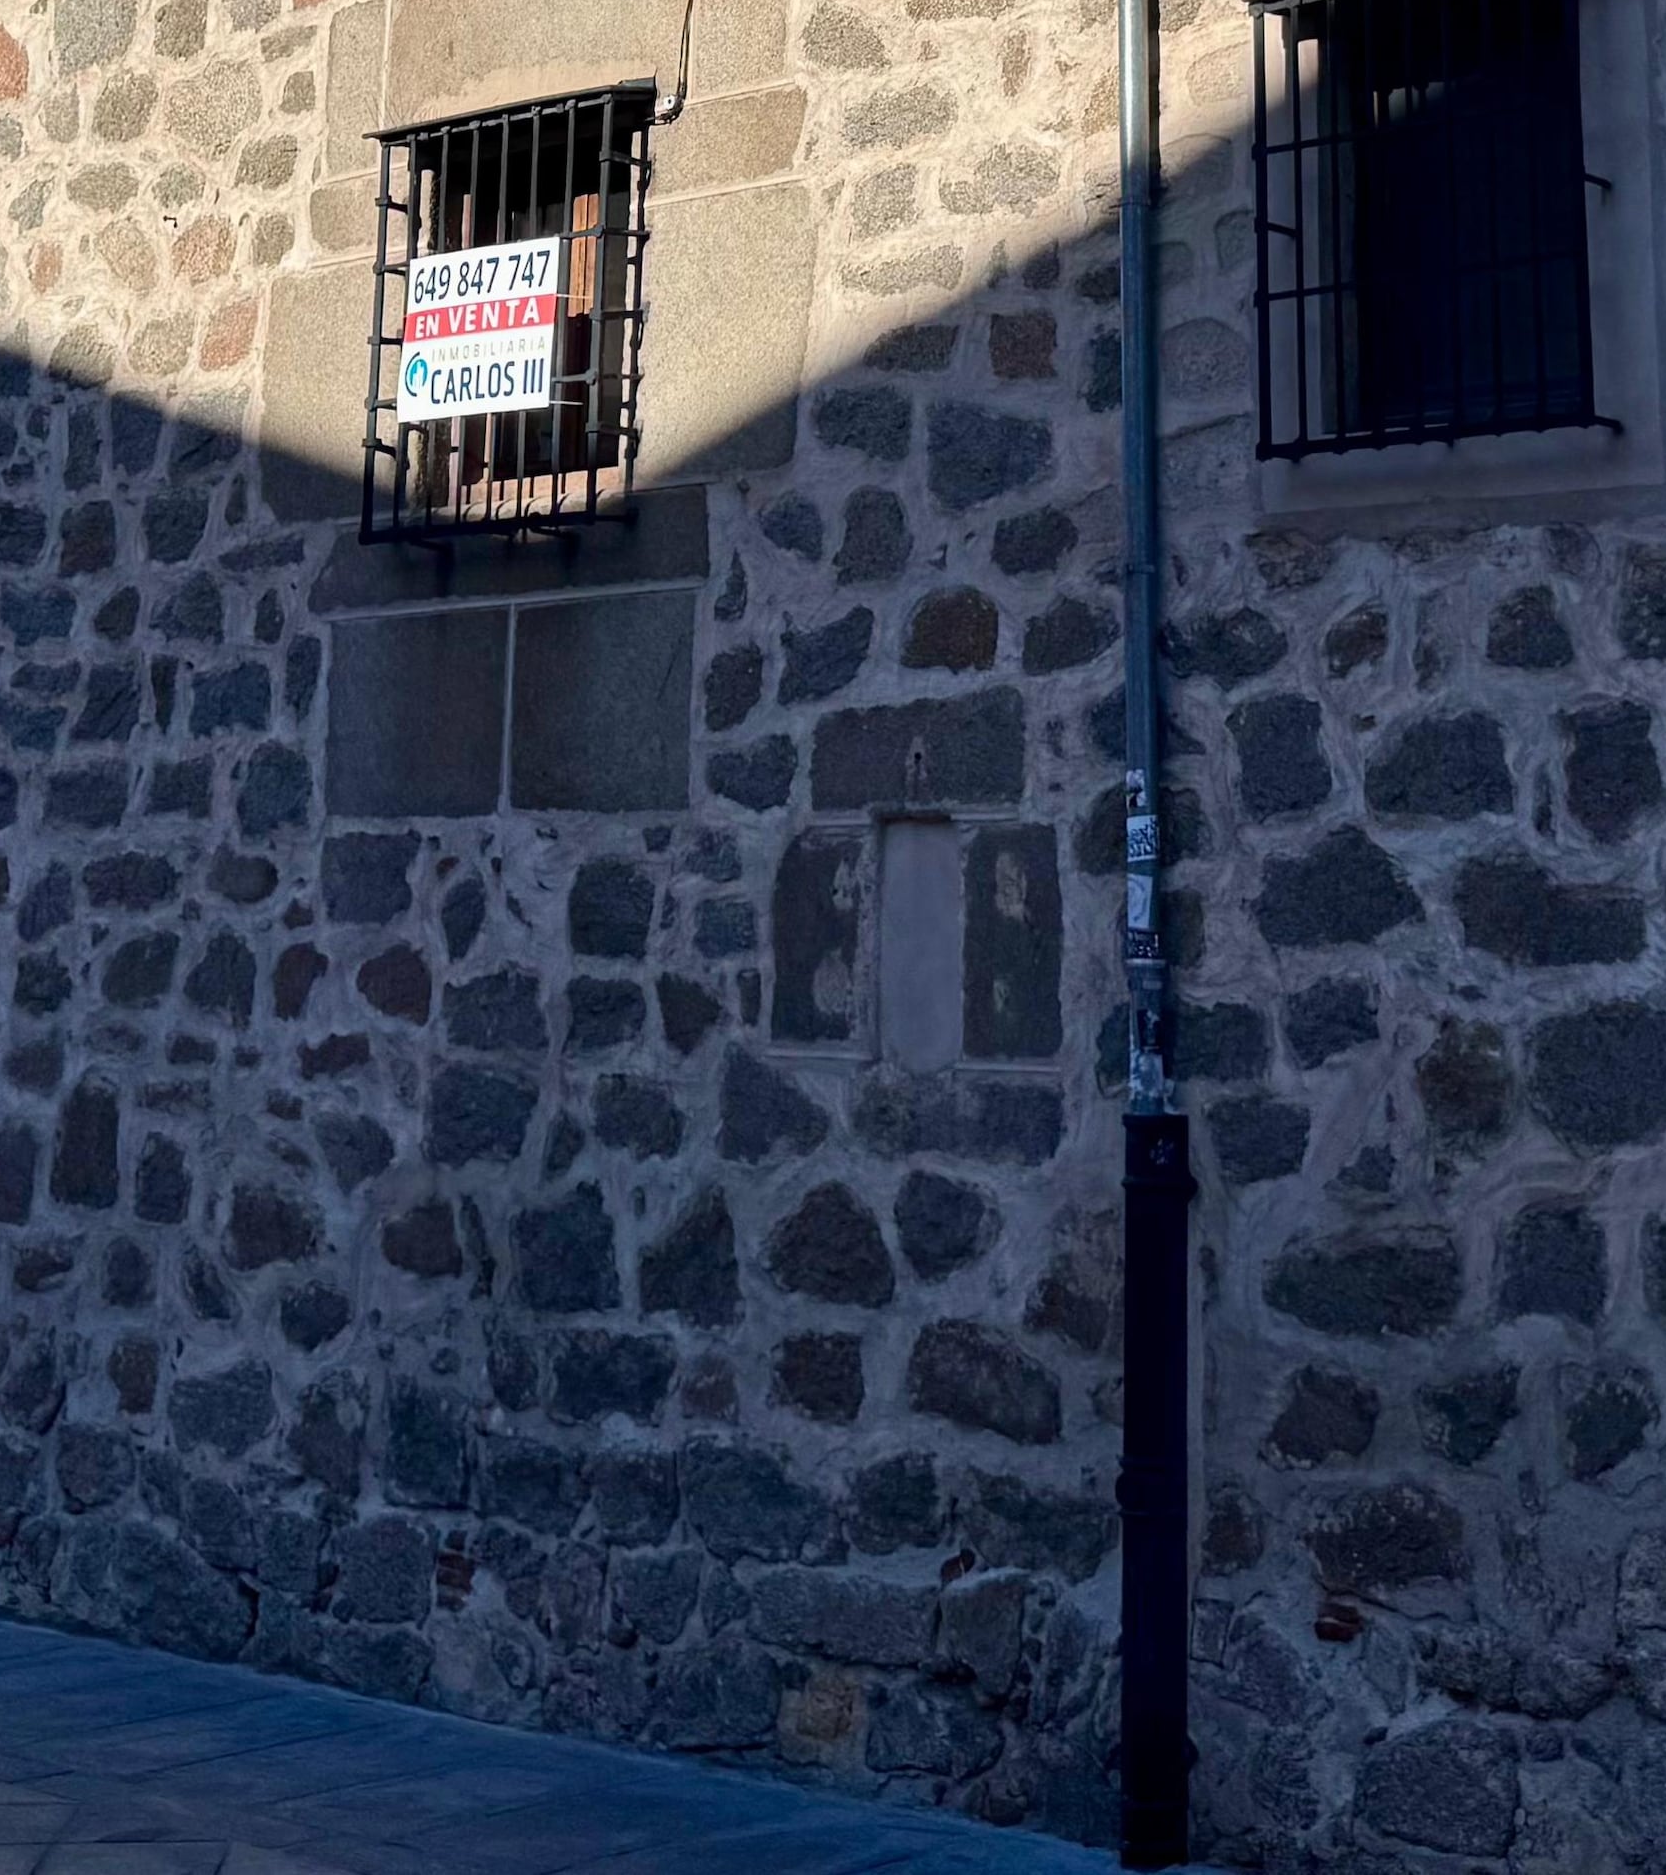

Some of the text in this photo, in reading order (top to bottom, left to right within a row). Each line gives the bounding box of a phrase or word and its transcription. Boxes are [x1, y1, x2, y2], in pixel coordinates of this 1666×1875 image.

[414, 250, 551, 304] 649 847 747
[415, 297, 541, 339] EN VENTA
[431, 335, 546, 363] INMOBILIARIA
[430, 357, 545, 405] CARLOS III
